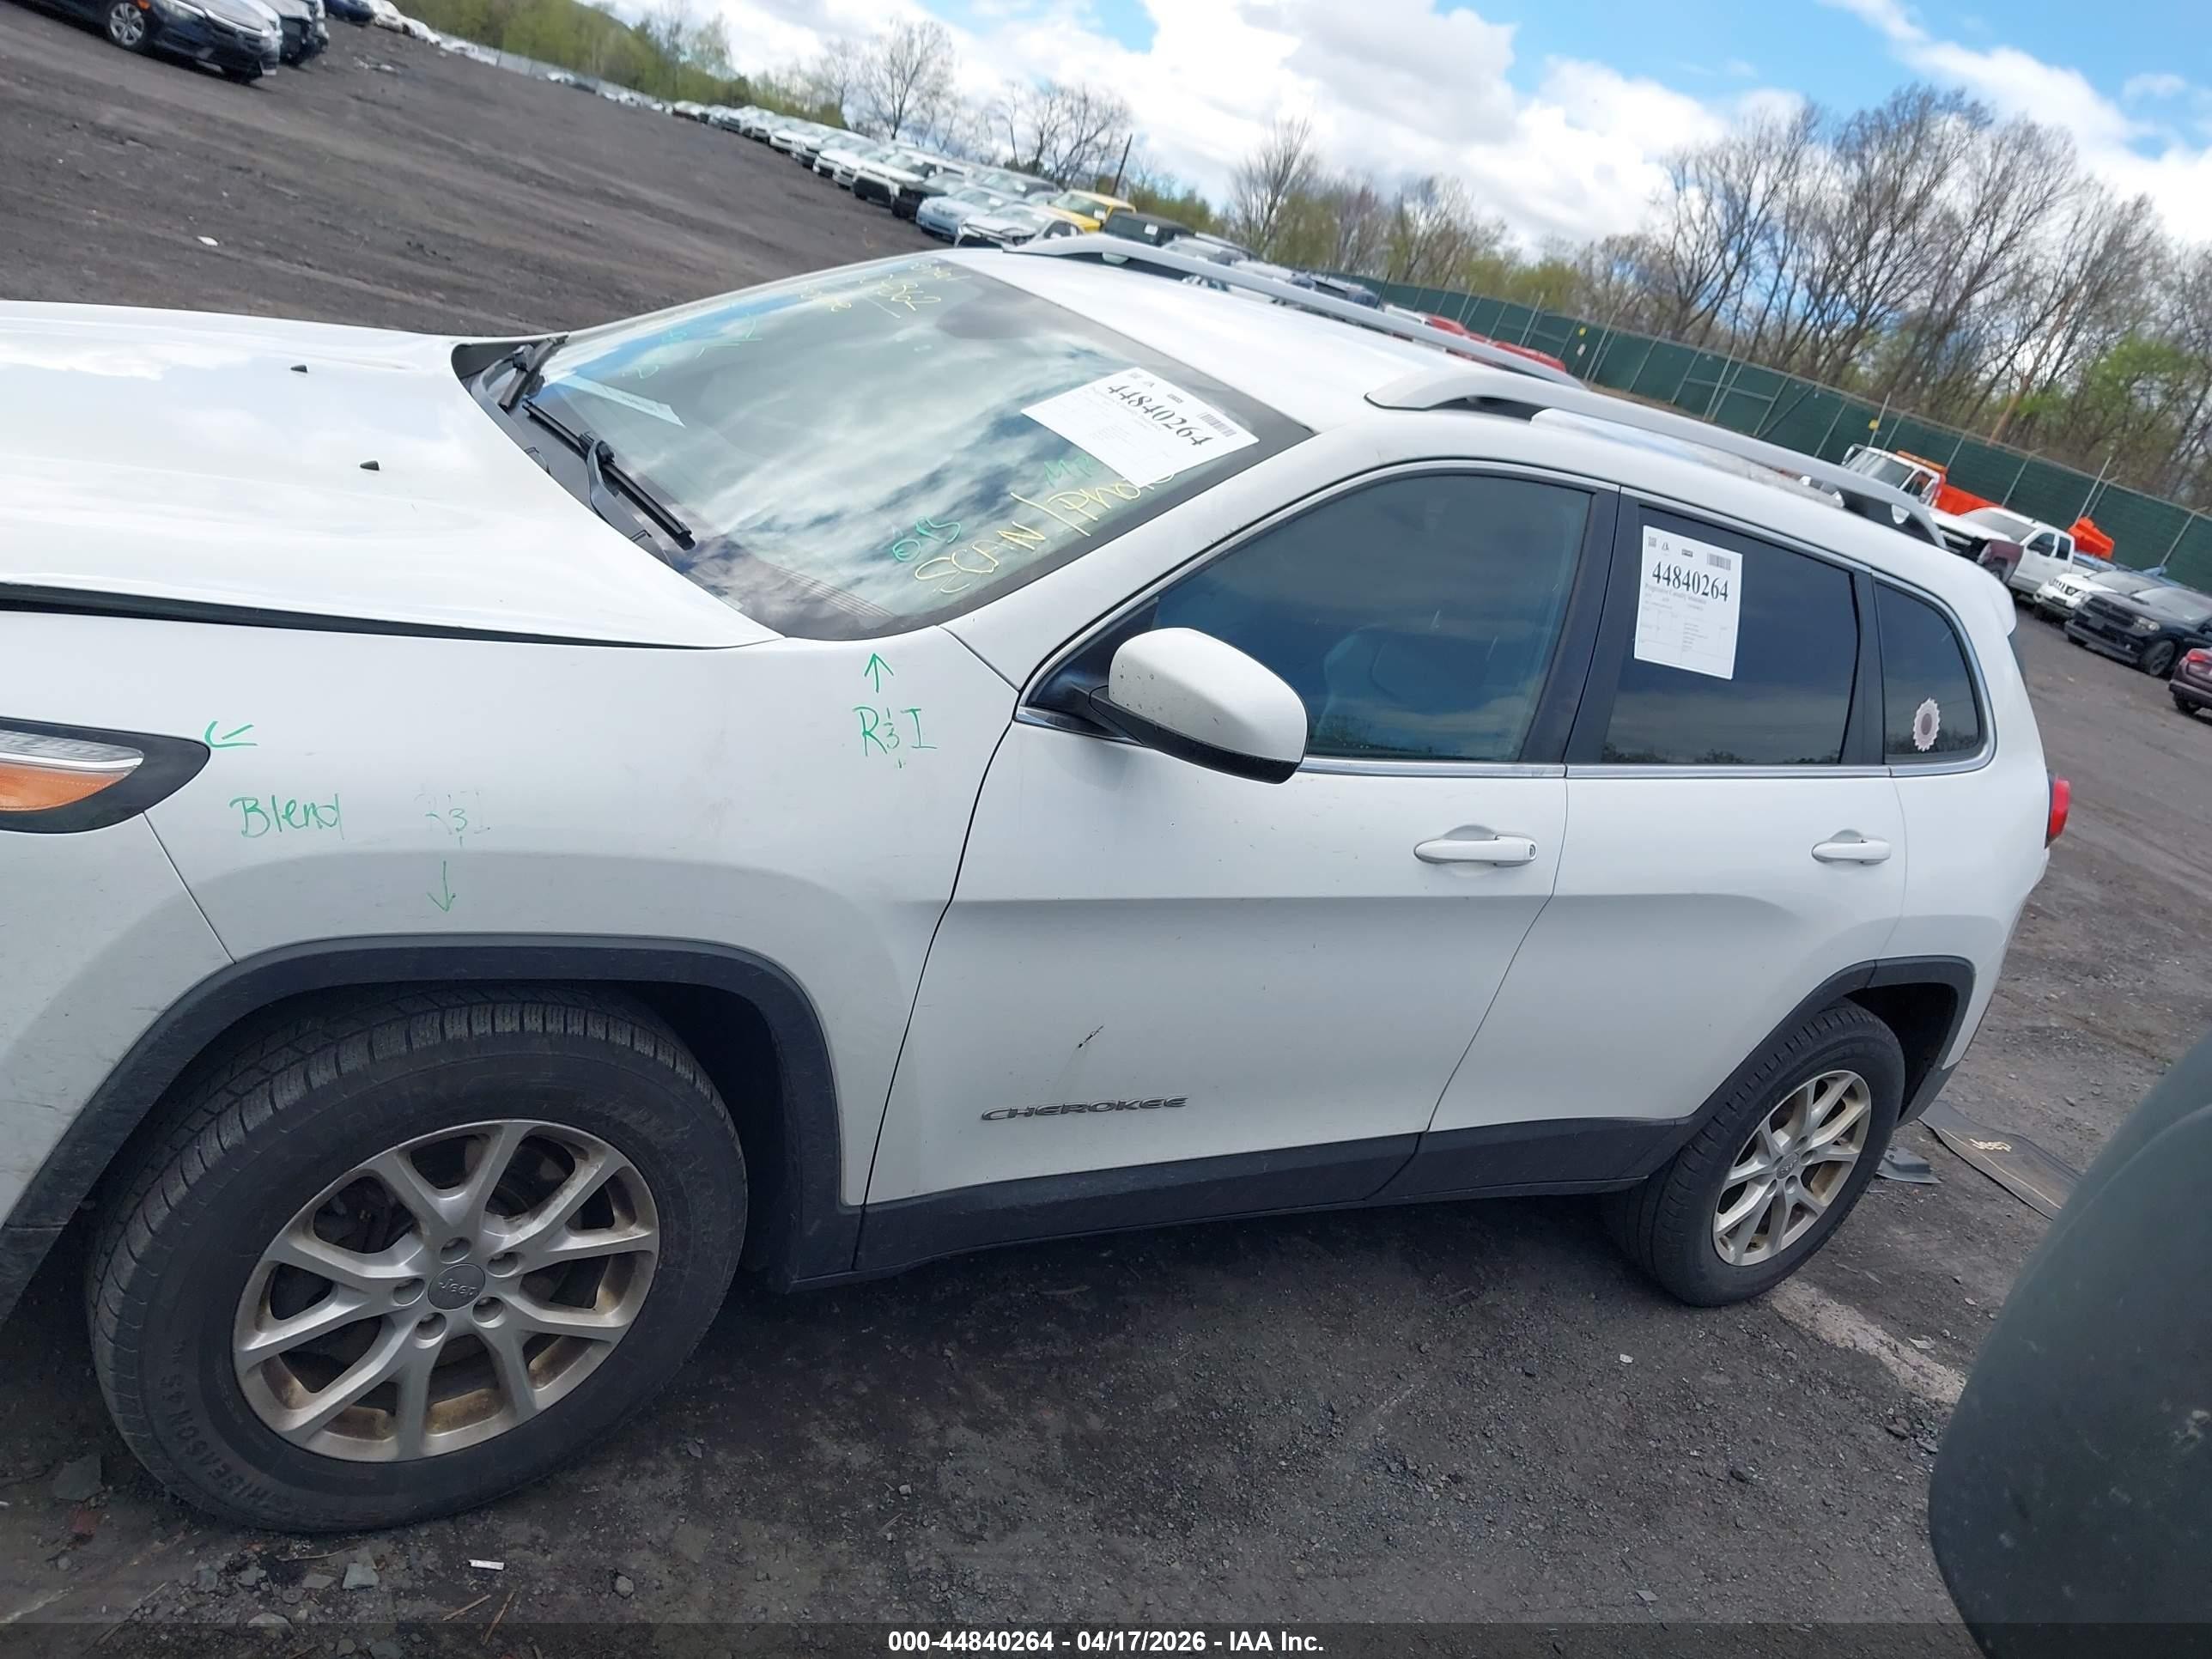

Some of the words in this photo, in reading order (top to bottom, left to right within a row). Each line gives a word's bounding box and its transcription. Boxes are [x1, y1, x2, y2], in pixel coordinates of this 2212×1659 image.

[1107, 385, 1213, 447] 44840264
[1652, 561, 1729, 602] 44840264
[229, 793, 344, 840] Blend
[981, 1095, 1189, 1121] CHEROKEE
[438, 1277, 478, 1297] Jeep
